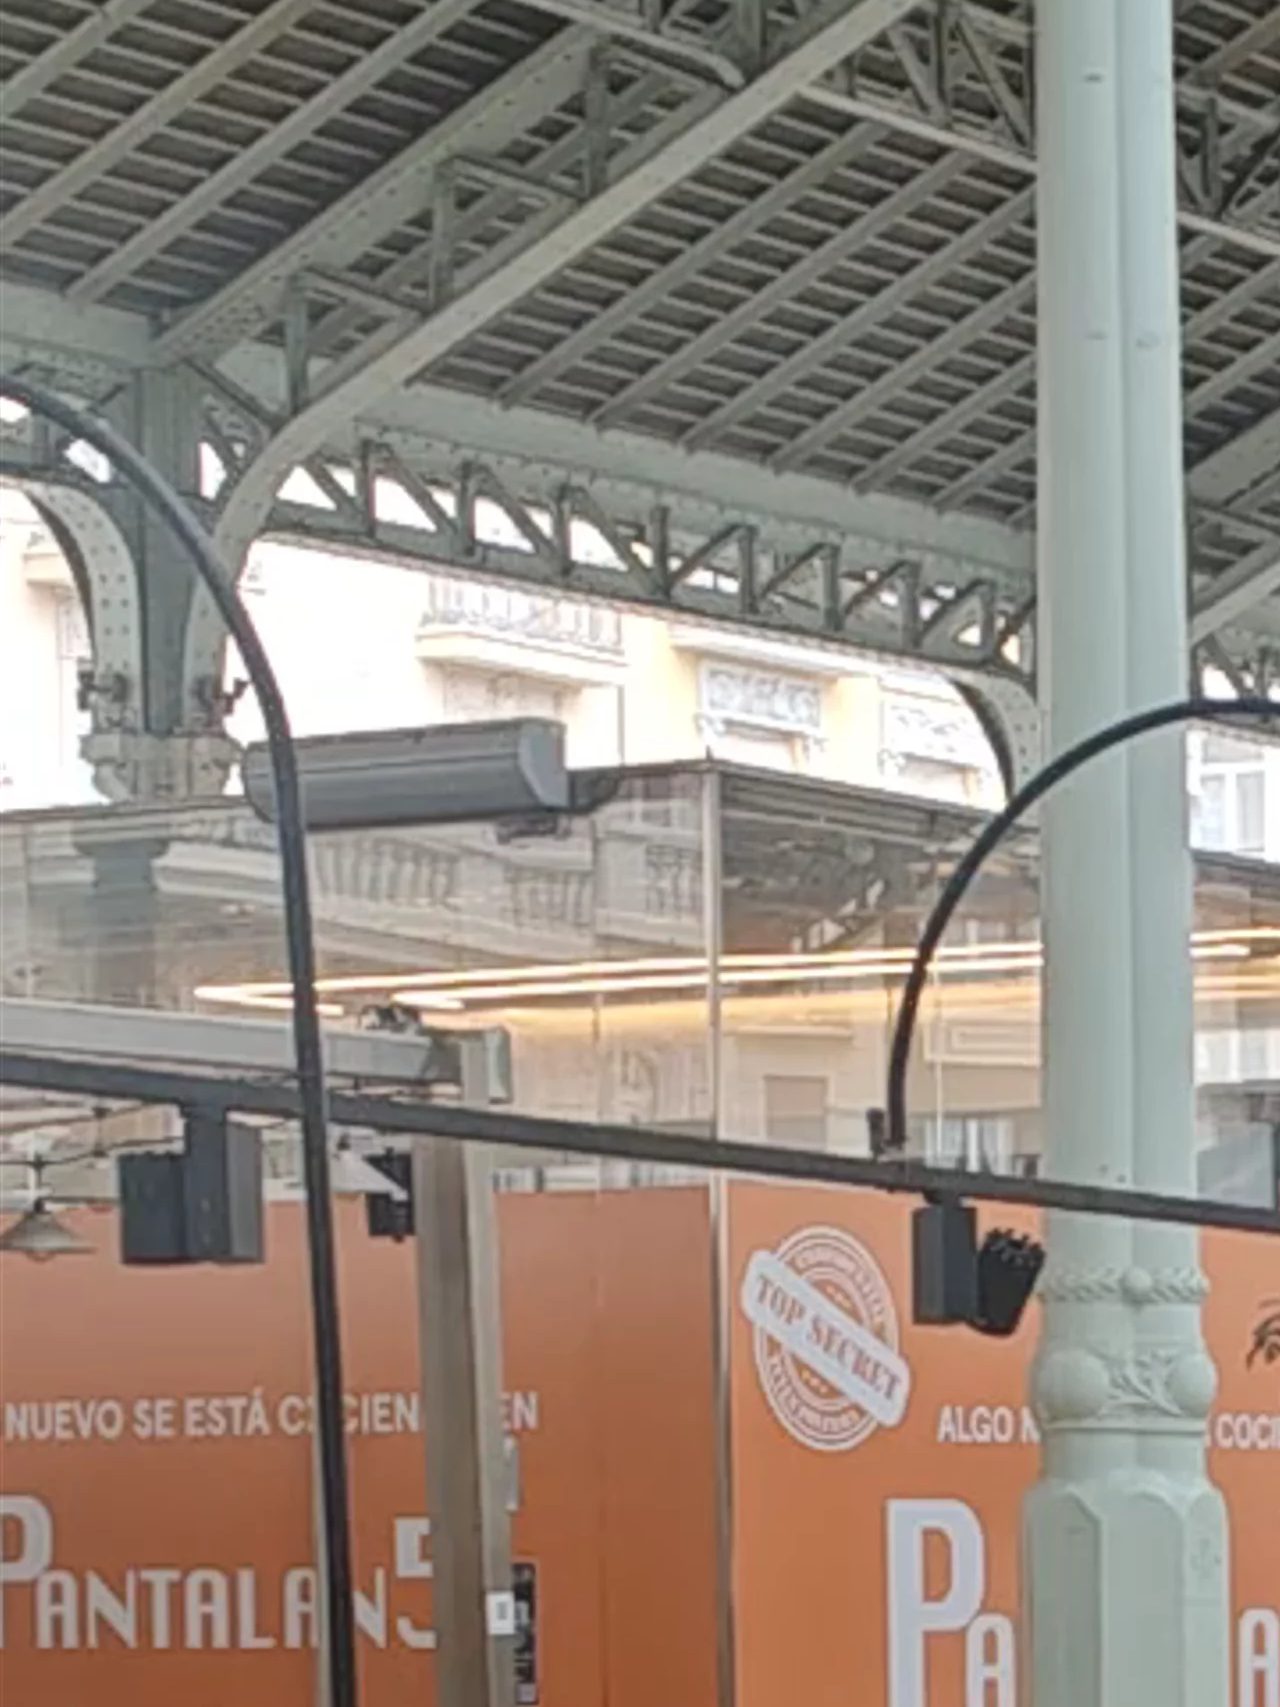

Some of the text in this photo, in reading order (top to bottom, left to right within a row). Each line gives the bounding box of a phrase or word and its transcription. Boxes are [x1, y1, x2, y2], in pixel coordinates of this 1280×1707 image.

[756, 1274, 805, 1326] TOP
[806, 1316, 902, 1400] SECRET
[4, 1400, 123, 1439] NUEVO
[133, 1397, 176, 1437] SE
[186, 1387, 269, 1436] ESTÁ
[938, 1406, 1013, 1443] ALGO
